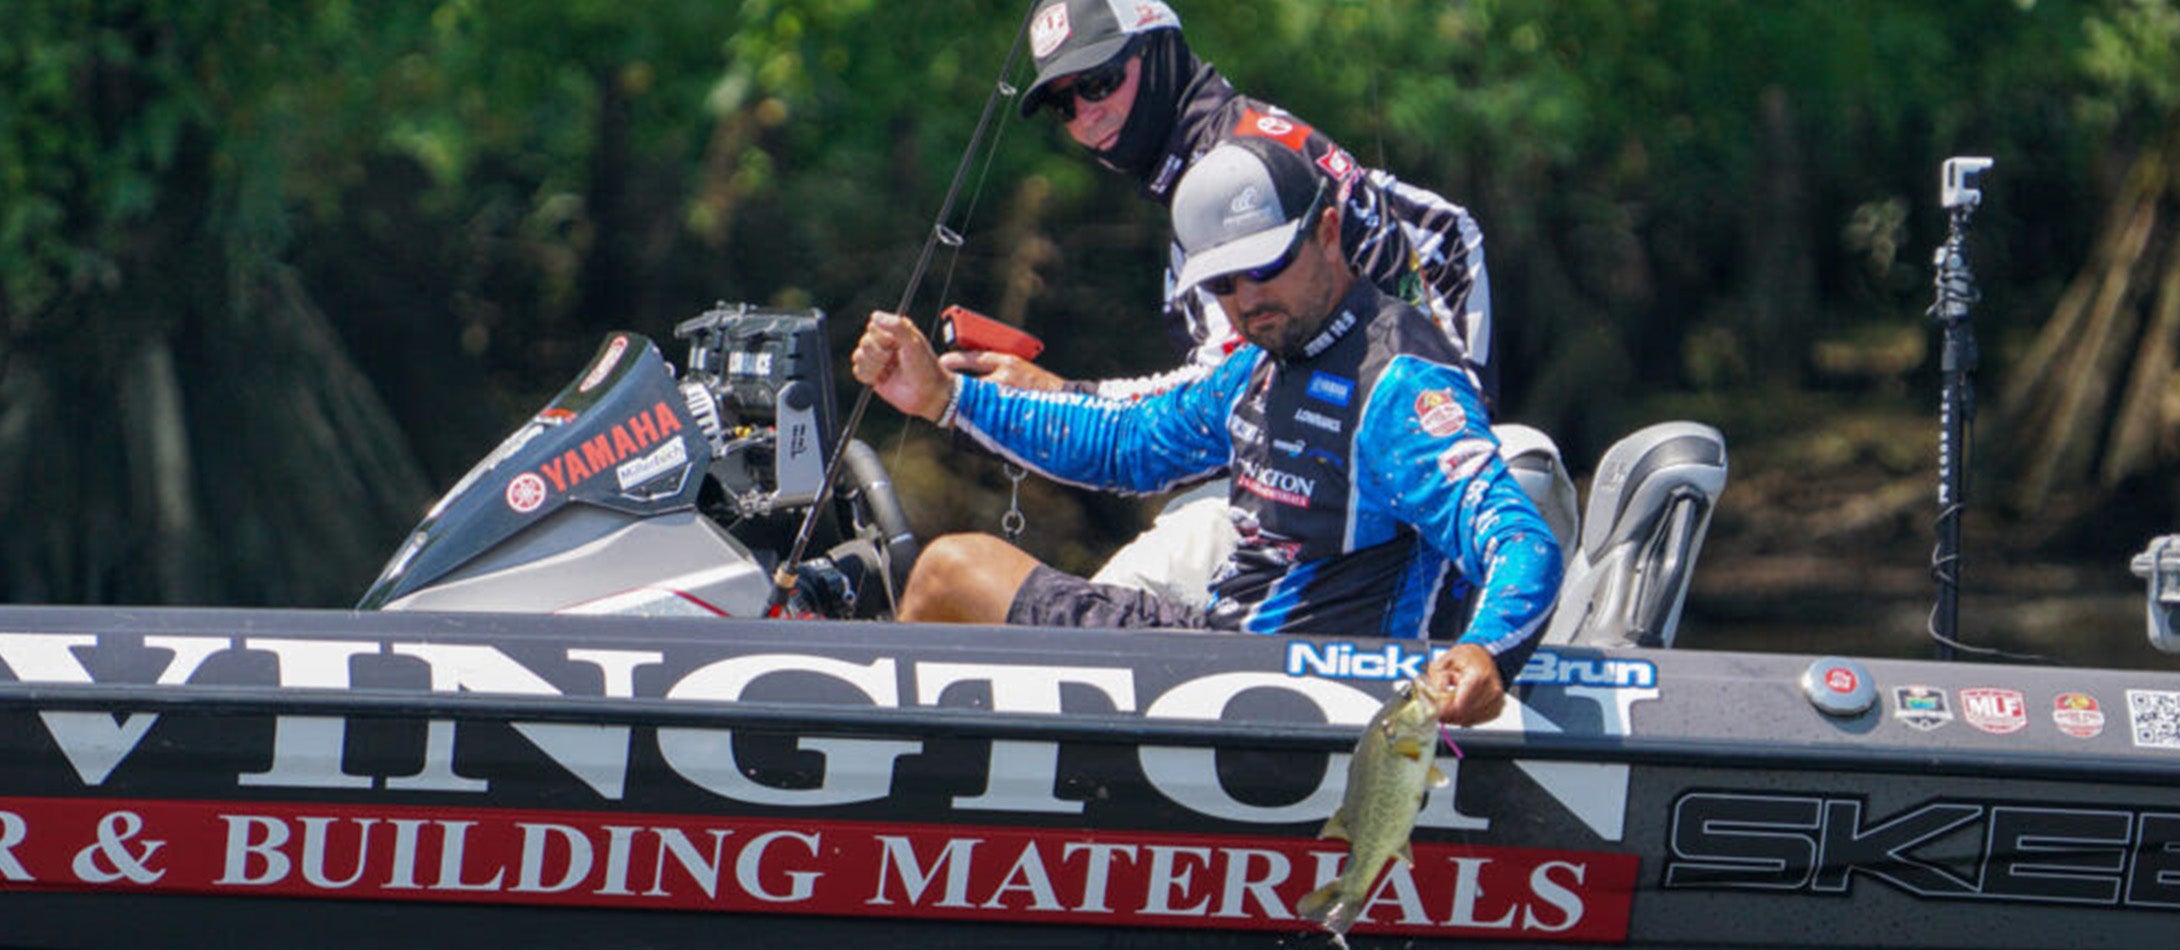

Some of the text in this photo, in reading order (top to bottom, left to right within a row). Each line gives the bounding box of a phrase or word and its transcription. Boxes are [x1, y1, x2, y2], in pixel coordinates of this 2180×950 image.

[540, 402, 682, 492] YAMAHA
[1289, 643, 1425, 680] Nick
[1968, 697, 2021, 718] MLF
[71, 811, 167, 884] &
[212, 814, 824, 902] BUILDING
[866, 834, 1587, 932] MATERIALS
